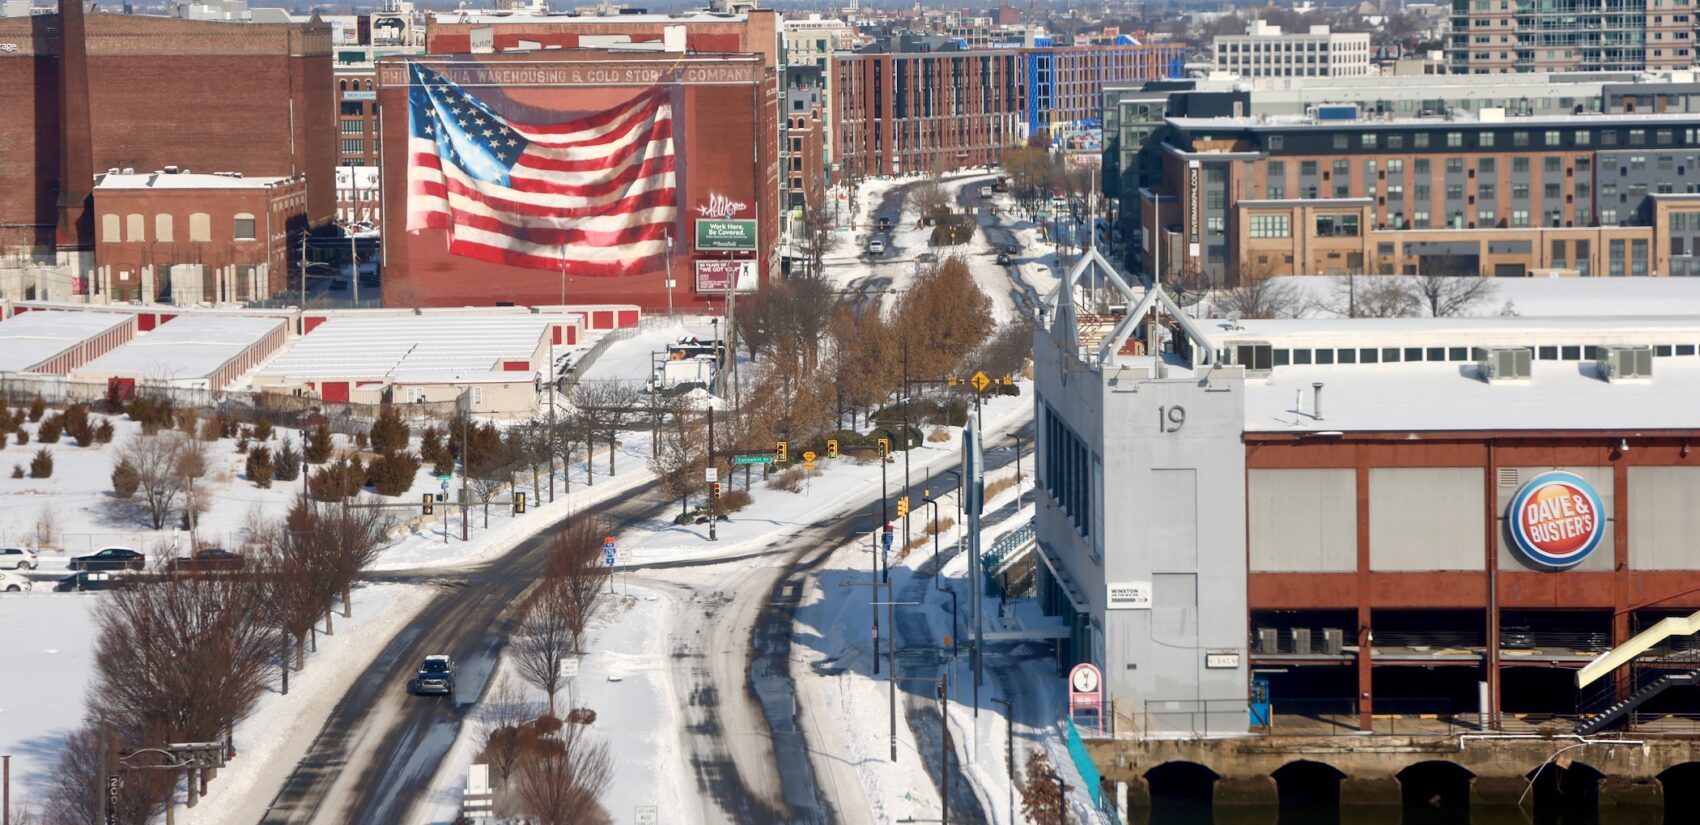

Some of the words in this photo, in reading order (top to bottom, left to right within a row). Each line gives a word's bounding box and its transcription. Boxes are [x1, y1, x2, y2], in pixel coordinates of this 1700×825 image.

[477, 70, 567, 83] WAREHOUSING
[572, 70, 583, 82] &
[588, 70, 619, 82] COLD
[689, 69, 751, 81] COMPANY
[1158, 405, 1185, 433] 19
[1528, 496, 1574, 525] DAVE
[1573, 494, 1590, 514] &
[1529, 514, 1592, 543] BUSTER'S
